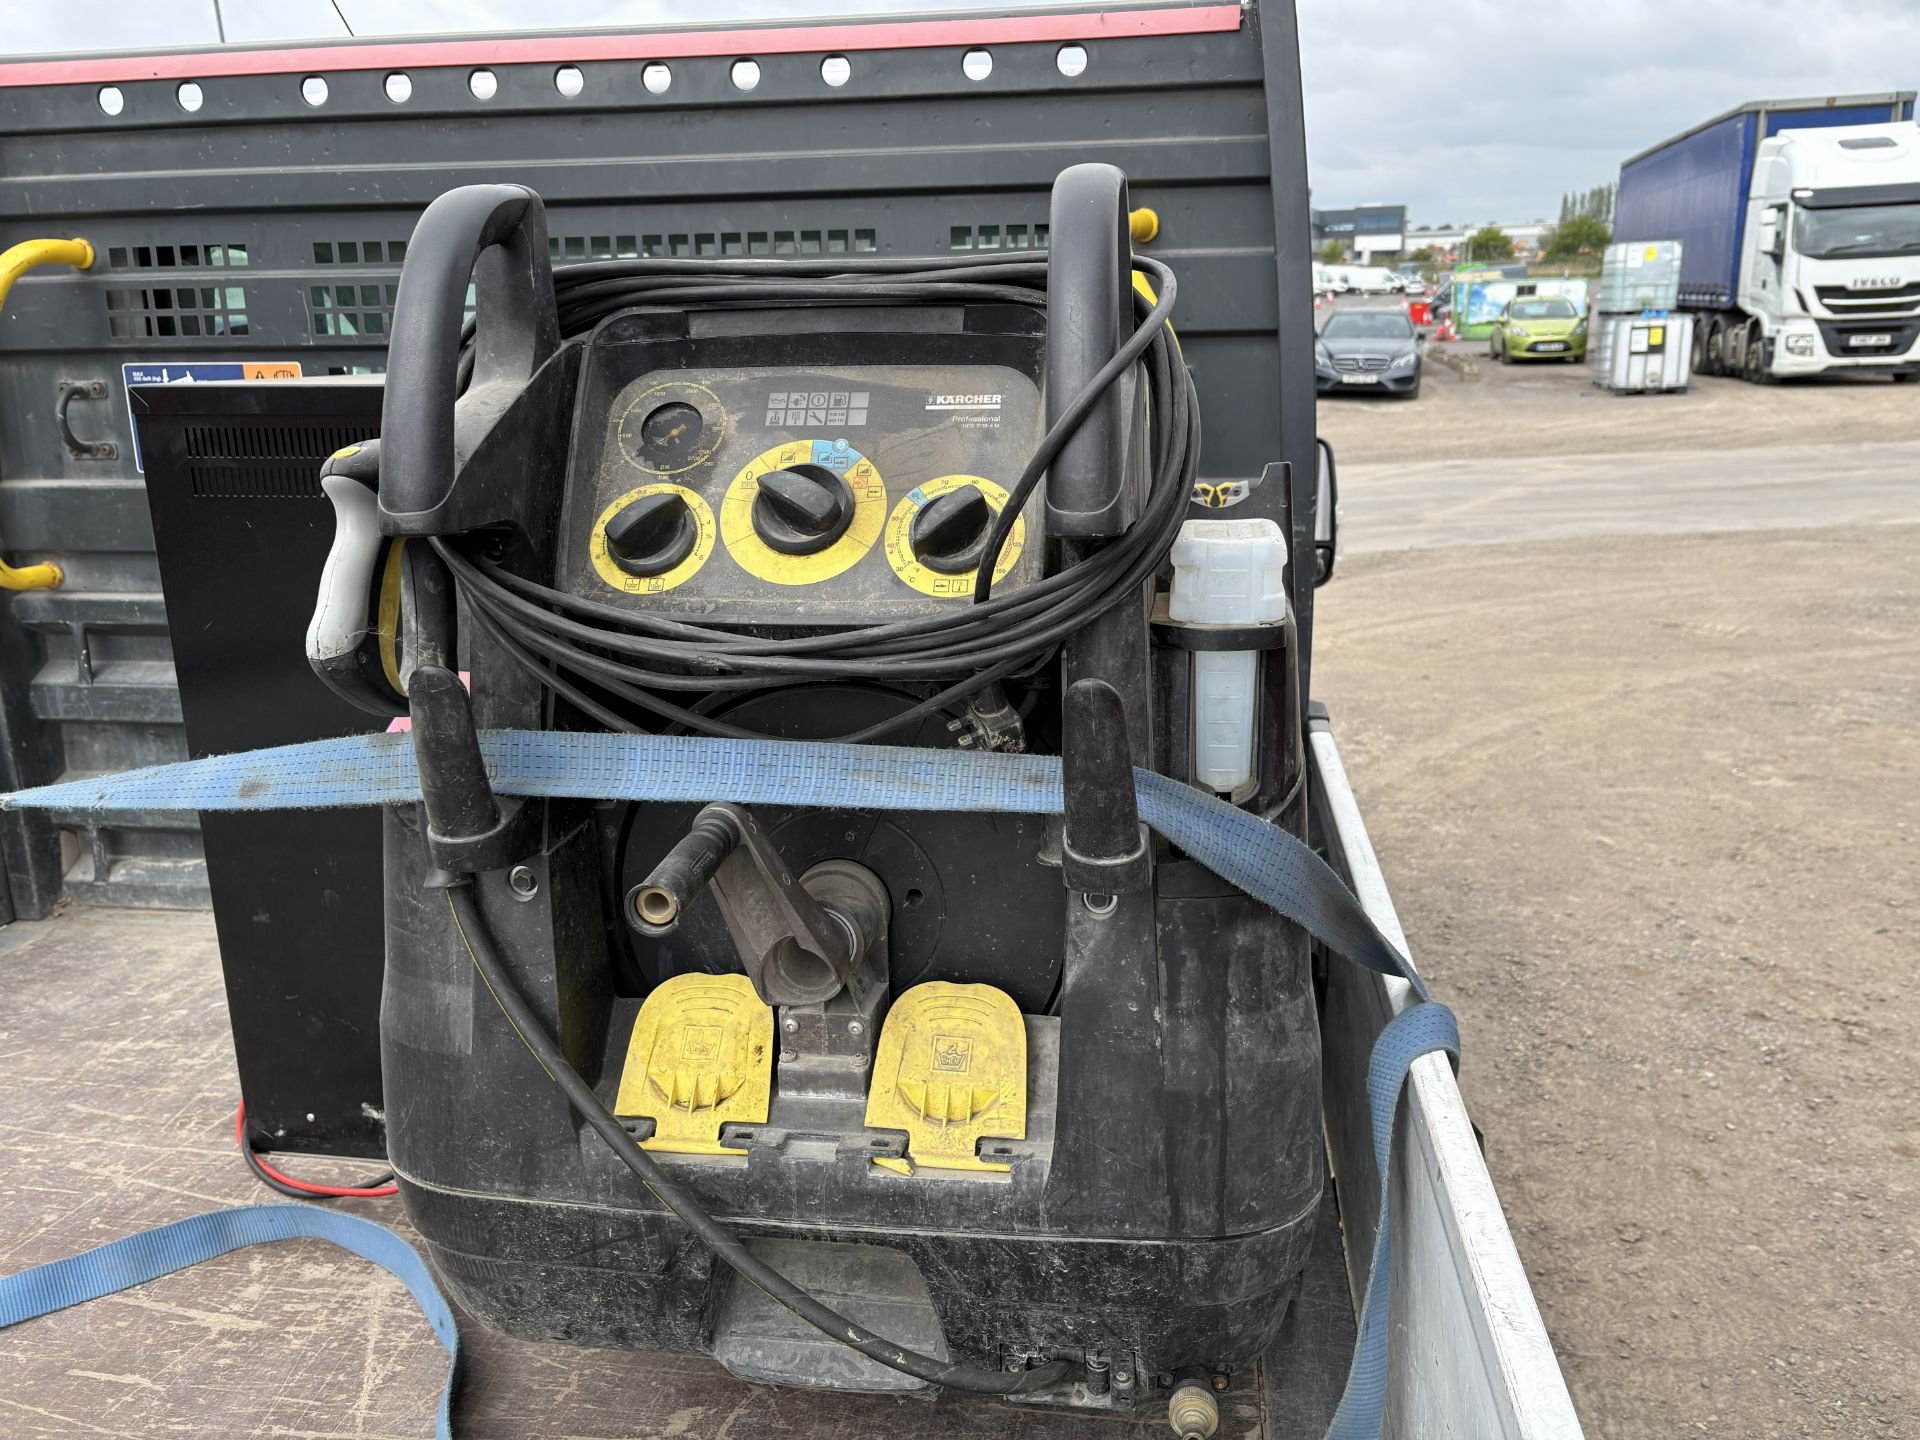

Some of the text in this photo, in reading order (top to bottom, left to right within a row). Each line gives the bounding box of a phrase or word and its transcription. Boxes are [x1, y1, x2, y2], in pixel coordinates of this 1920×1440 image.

[1853, 277, 1900, 287] IVECO
[936, 394, 1002, 404] KÄRCHER
[952, 415, 1001, 423] Professional
[948, 1042, 957, 1054] 2
